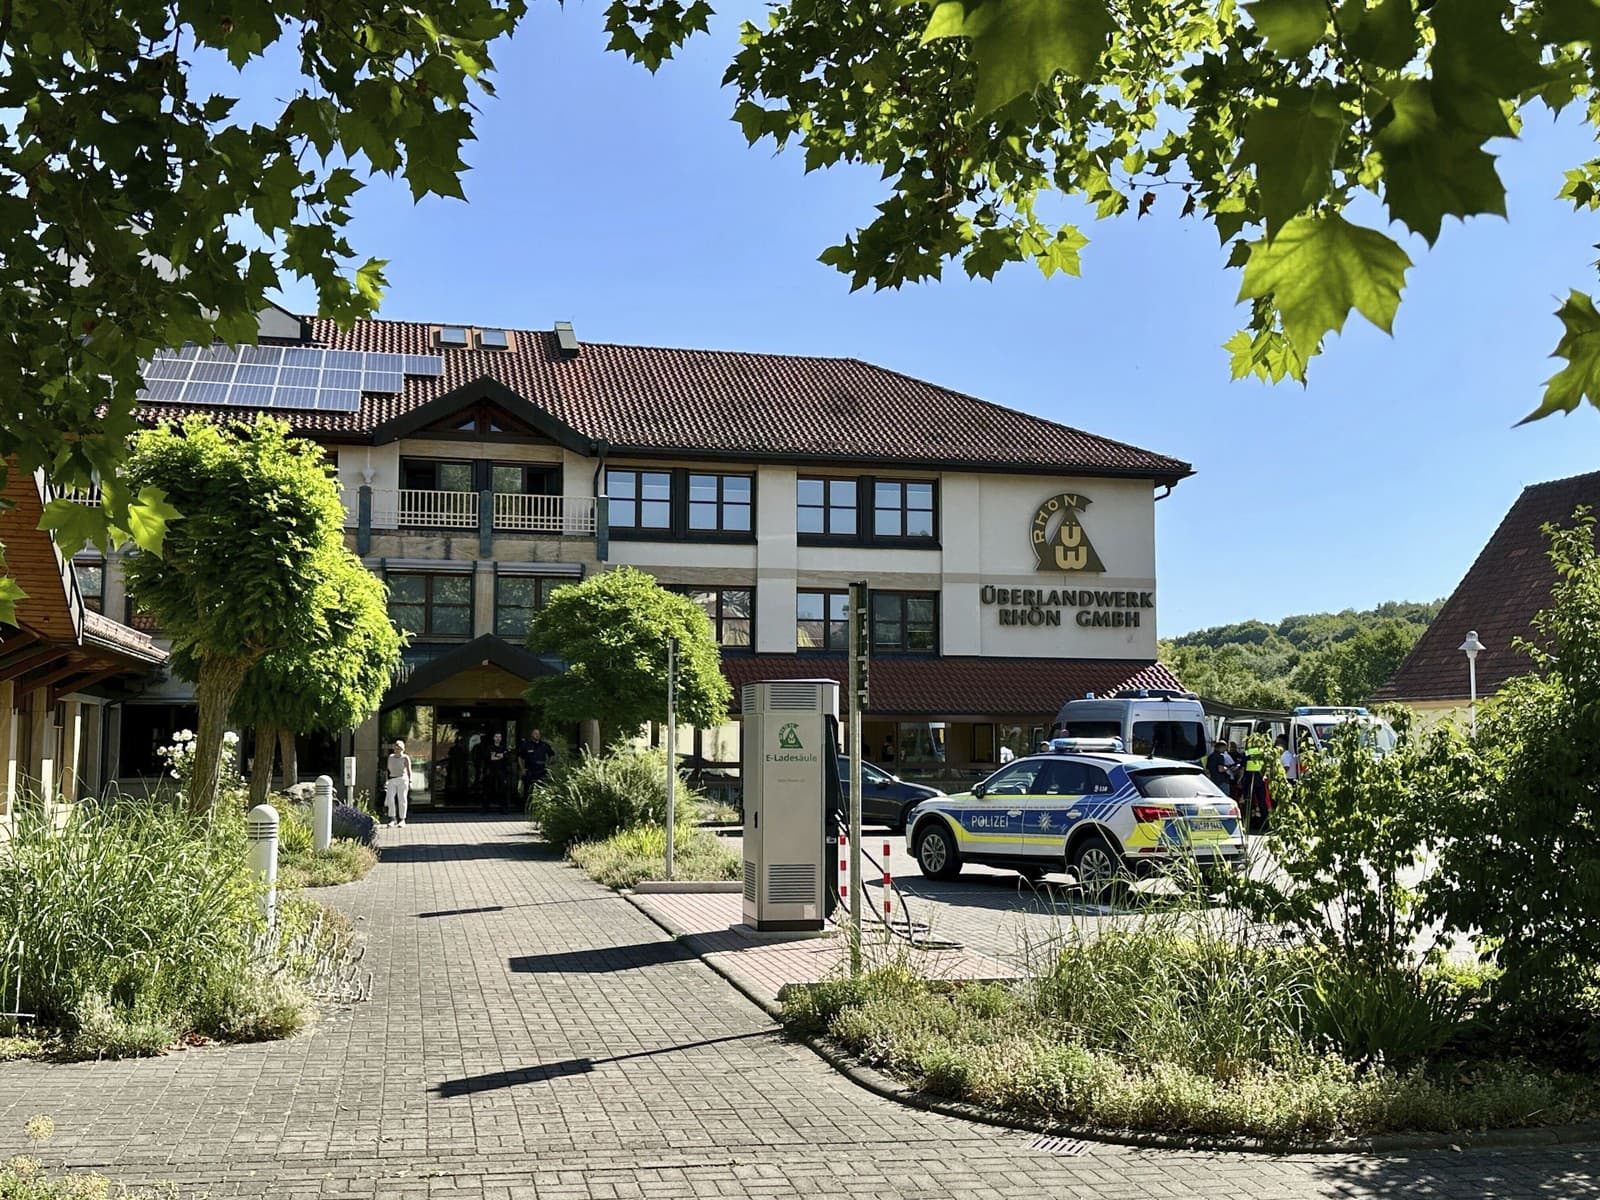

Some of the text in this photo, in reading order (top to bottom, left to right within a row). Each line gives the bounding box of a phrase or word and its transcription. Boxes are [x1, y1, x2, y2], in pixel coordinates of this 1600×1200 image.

[1034, 495, 1077, 543] RHÖN
[980, 585, 1154, 609] ÜBERLANDWERK
[999, 607, 1141, 628] RHÖN GMBH
[971, 815, 1009, 828] POLIZEI
